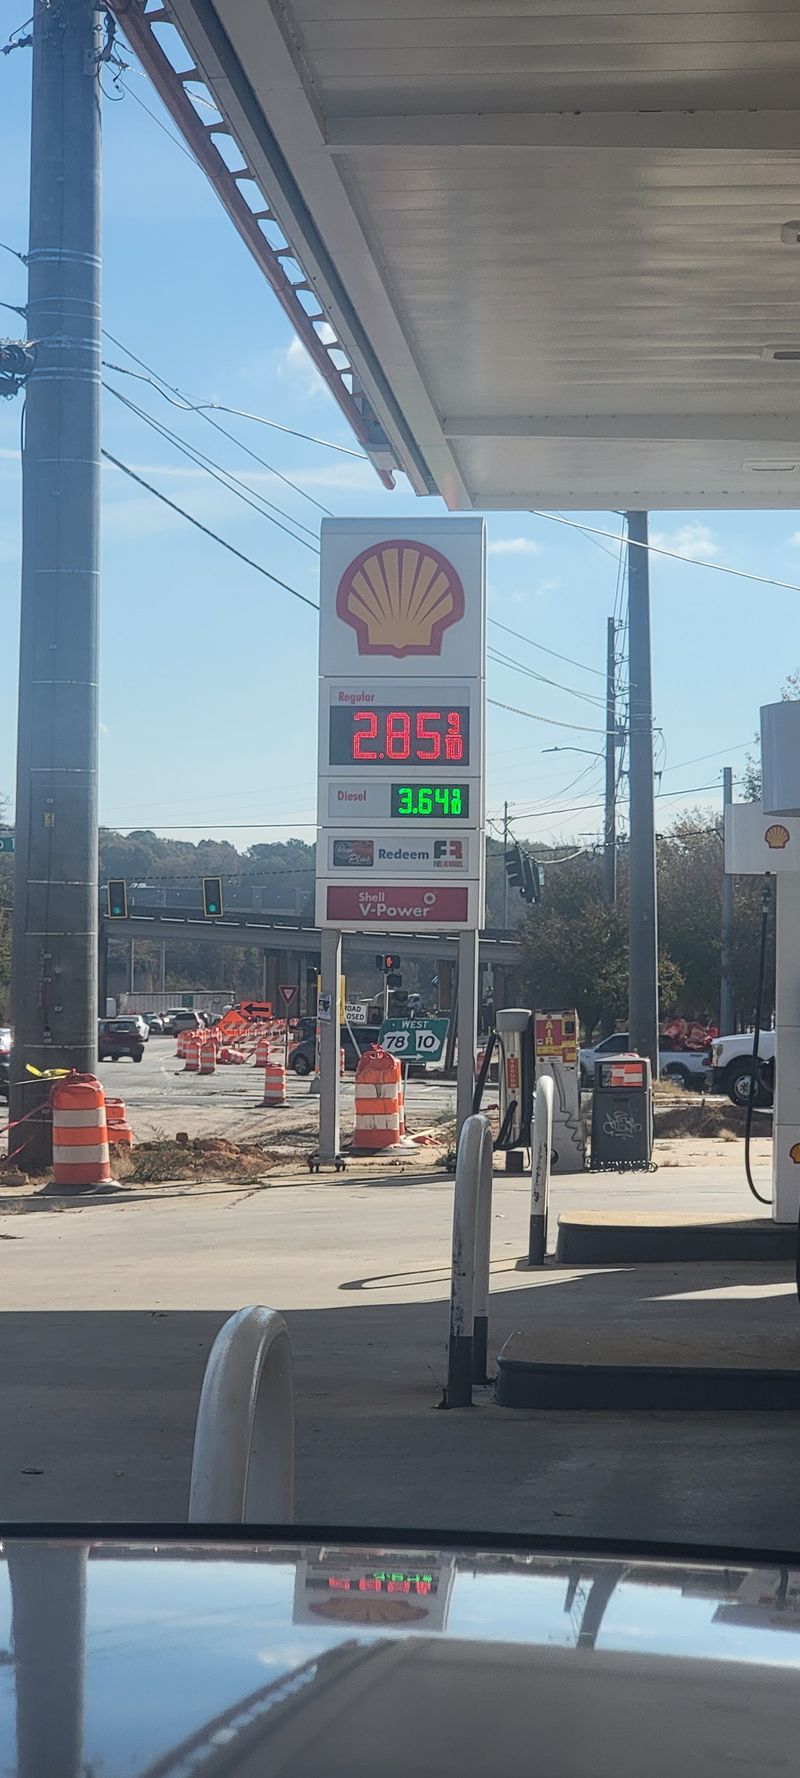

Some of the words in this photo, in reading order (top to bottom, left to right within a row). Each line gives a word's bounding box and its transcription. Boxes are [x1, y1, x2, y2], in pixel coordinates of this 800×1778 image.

[338, 691, 375, 704] Regular
[337, 790, 367, 801] Diesel
[378, 849, 430, 860] Redeem
[358, 892, 385, 902] Shell
[358, 903, 431, 917] V-Power
[401, 1020, 429, 1029] WEST
[545, 1021, 553, 1046] AIR
[386, 1036, 405, 1049] 78
[418, 1035, 435, 1049] 10
